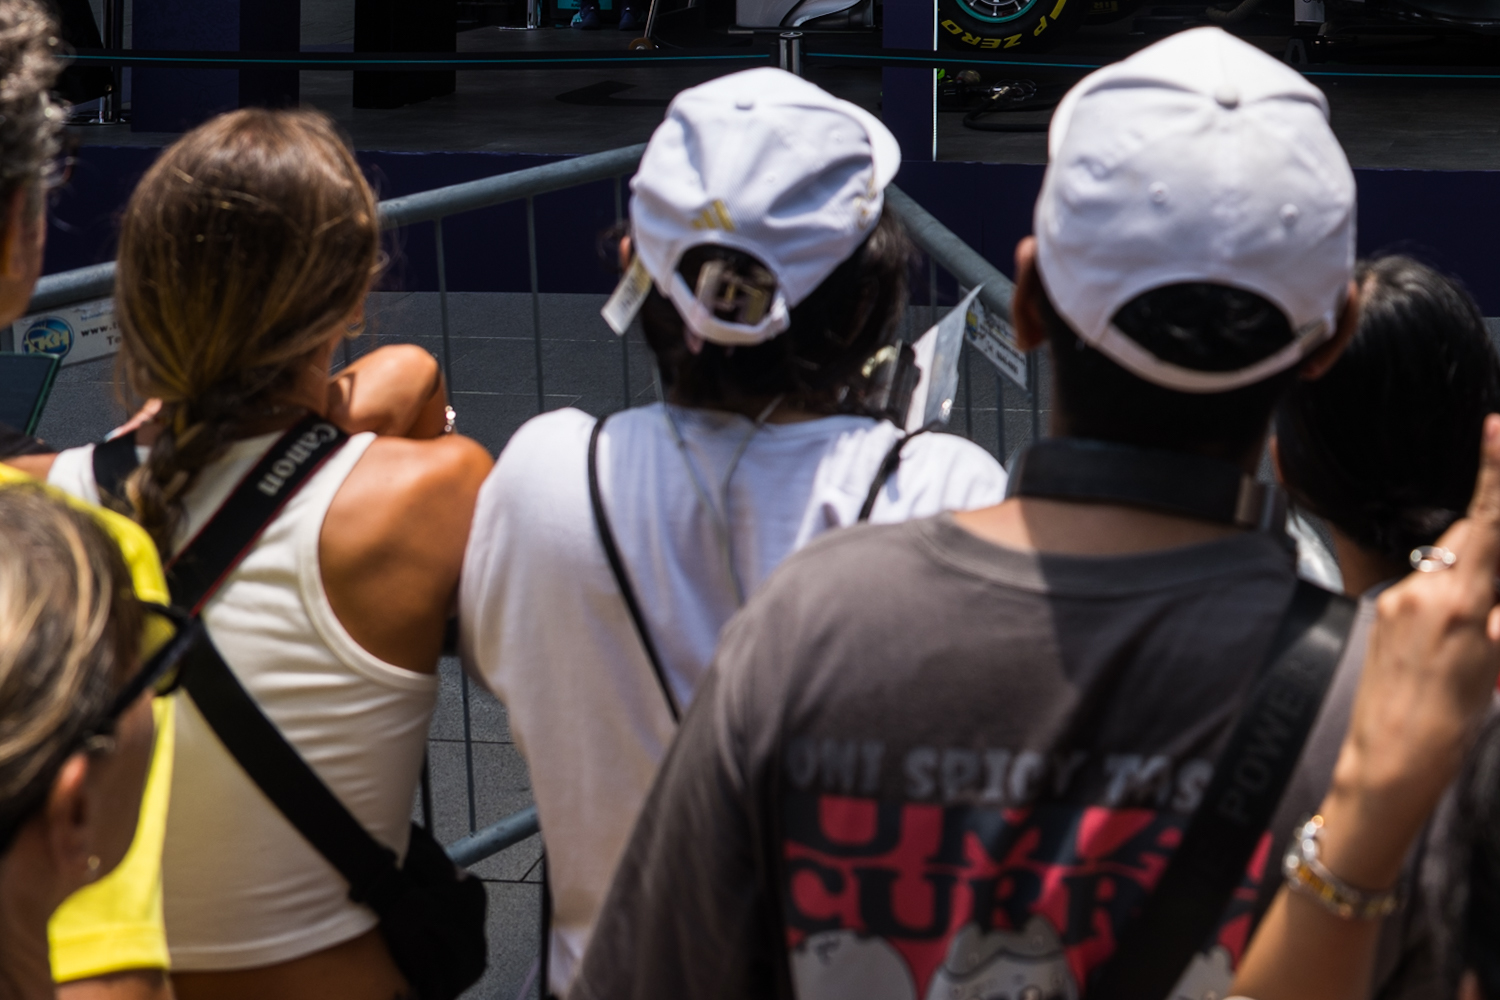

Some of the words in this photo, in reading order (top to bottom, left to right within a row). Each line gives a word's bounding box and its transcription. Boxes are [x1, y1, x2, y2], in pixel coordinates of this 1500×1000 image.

[941, 19, 1023, 49] ZERO
[1033, 15, 1048, 37] P
[257, 423, 338, 497] Canon
[904, 746, 1089, 800] SPICY
